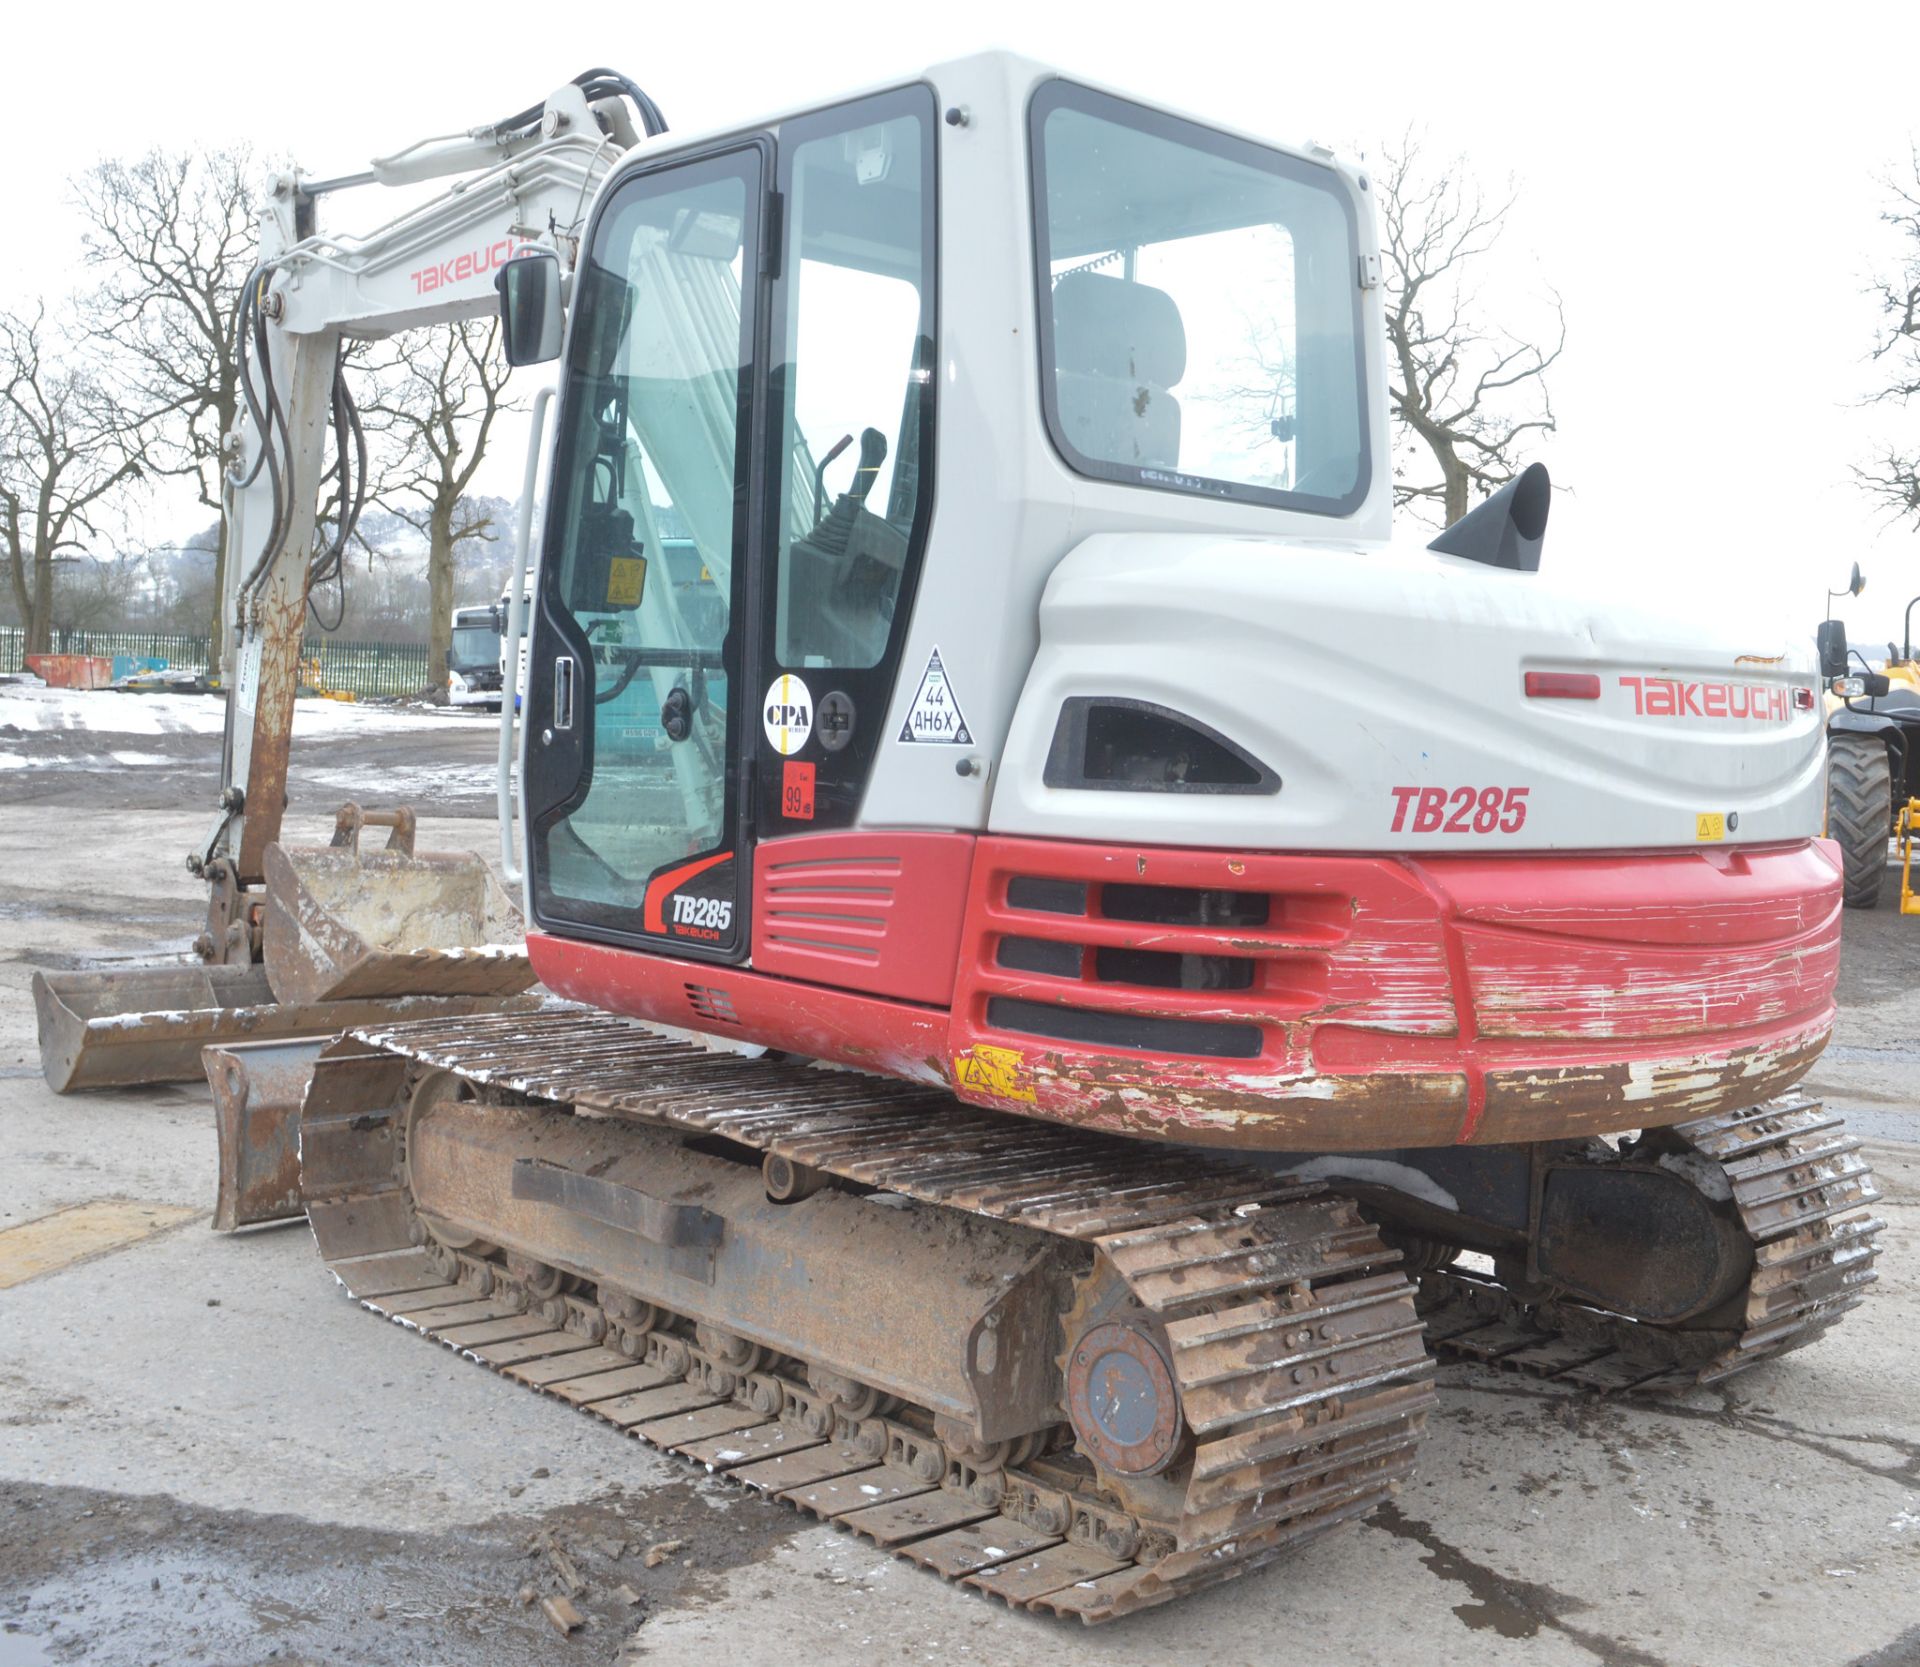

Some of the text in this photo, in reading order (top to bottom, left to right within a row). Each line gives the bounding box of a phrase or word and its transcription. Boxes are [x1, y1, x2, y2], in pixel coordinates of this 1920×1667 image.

[926, 686, 943, 706] 44
[1619, 677, 1789, 721] TAKEUCHI
[767, 705, 809, 727] CPA
[914, 711, 953, 732] AH6X
[786, 786, 801, 813] 99
[1390, 786, 1530, 834] TB285
[673, 894, 732, 930] TB285
[673, 924, 720, 940] TAKEUCHI
